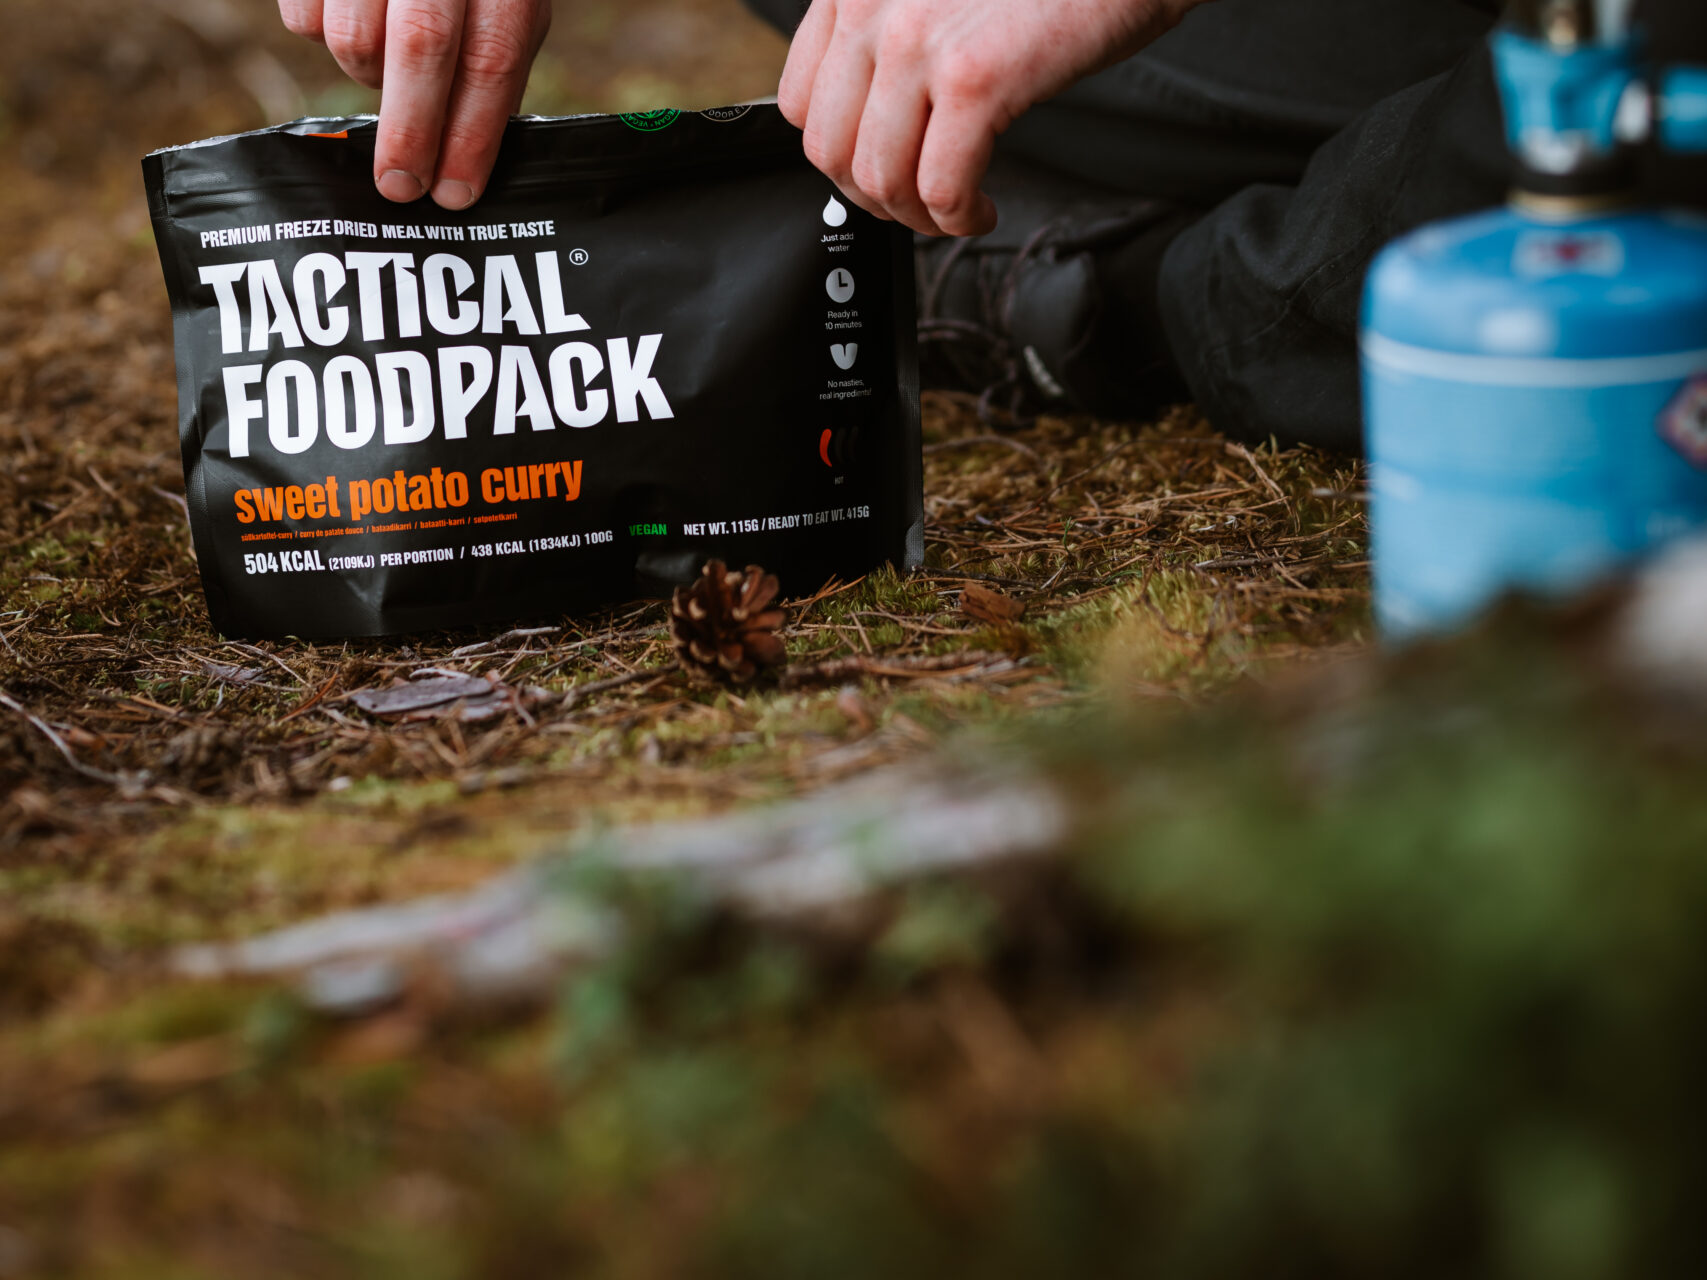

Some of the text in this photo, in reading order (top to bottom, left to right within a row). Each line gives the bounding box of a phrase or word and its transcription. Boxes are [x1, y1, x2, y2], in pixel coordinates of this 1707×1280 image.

[200, 220, 555, 248] PREMIUM FREEZE DRIED MEAL WITH TRUE TASTE
[821, 232, 854, 242] Just add
[828, 244, 850, 252] water
[198, 250, 591, 354] TACTICAL
[827, 309, 858, 319] Ready in
[825, 321, 862, 330] 10 minutes
[827, 379, 864, 388] No nasties,
[222, 333, 674, 458] FOODPACK
[819, 392, 832, 400] real
[234, 460, 583, 524] sweet potato curry
[683, 523, 705, 536] NET
[708, 521, 729, 535] WT.
[731, 519, 759, 533] 115G
[768, 515, 800, 530] READY
[802, 513, 813, 526] TO
[815, 511, 829, 524] EAT
[831, 508, 845, 521] WT.
[847, 505, 870, 519] 415G
[325, 528, 344, 537] patate
[345, 526, 364, 535] douce
[628, 523, 667, 537] VEGAN
[244, 552, 279, 575] 504
[280, 549, 325, 572] KCAL
[328, 554, 375, 571] (2109KJ)
[380, 553, 402, 567] PER
[403, 547, 454, 564] PORTION
[471, 544, 493, 557] 438
[495, 540, 526, 555] KCAL
[529, 534, 581, 553] (1834KJ)
[584, 530, 613, 545] 100G
